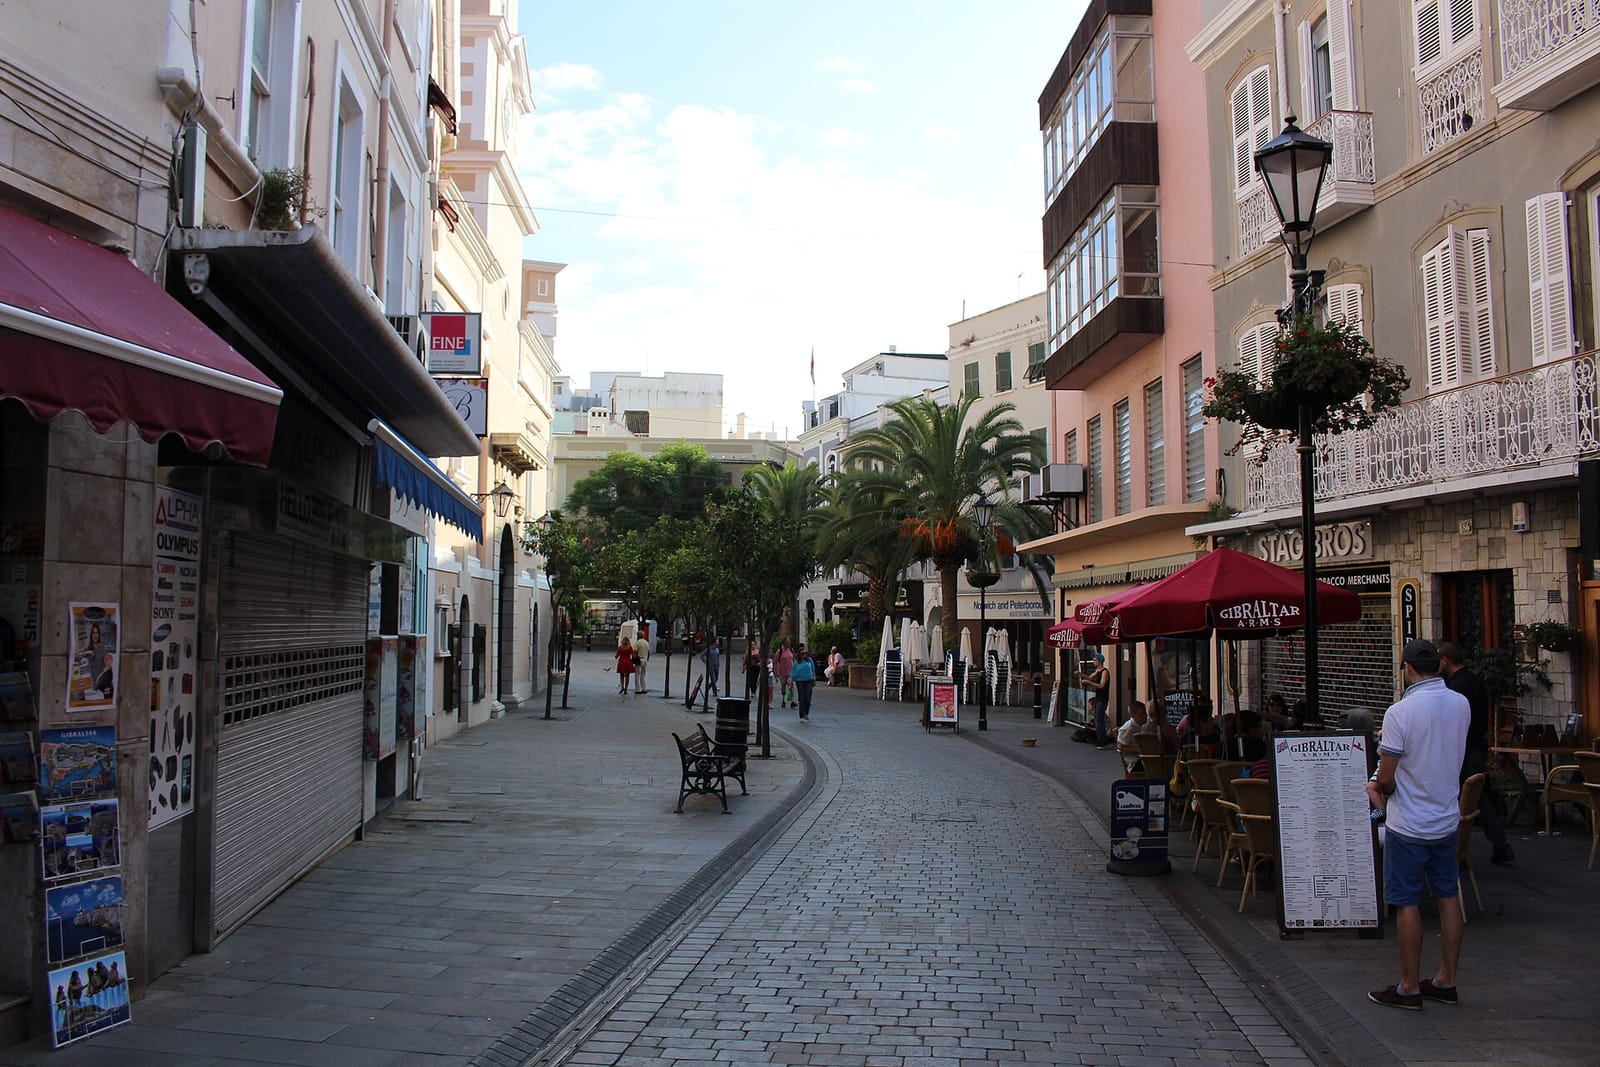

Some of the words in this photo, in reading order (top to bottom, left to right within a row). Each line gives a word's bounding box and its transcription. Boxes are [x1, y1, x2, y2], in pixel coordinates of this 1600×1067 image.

[432, 336, 465, 349] FINE
[155, 496, 199, 525] ALPHA
[157, 532, 199, 555] OLYMPUS
[1347, 573, 1390, 585] MERCHANTS
[997, 601, 1009, 610] and
[1219, 599, 1300, 619] GIBRALTAR
[153, 607, 175, 620] SONY
[1290, 739, 1351, 753] GIBRALTAR
